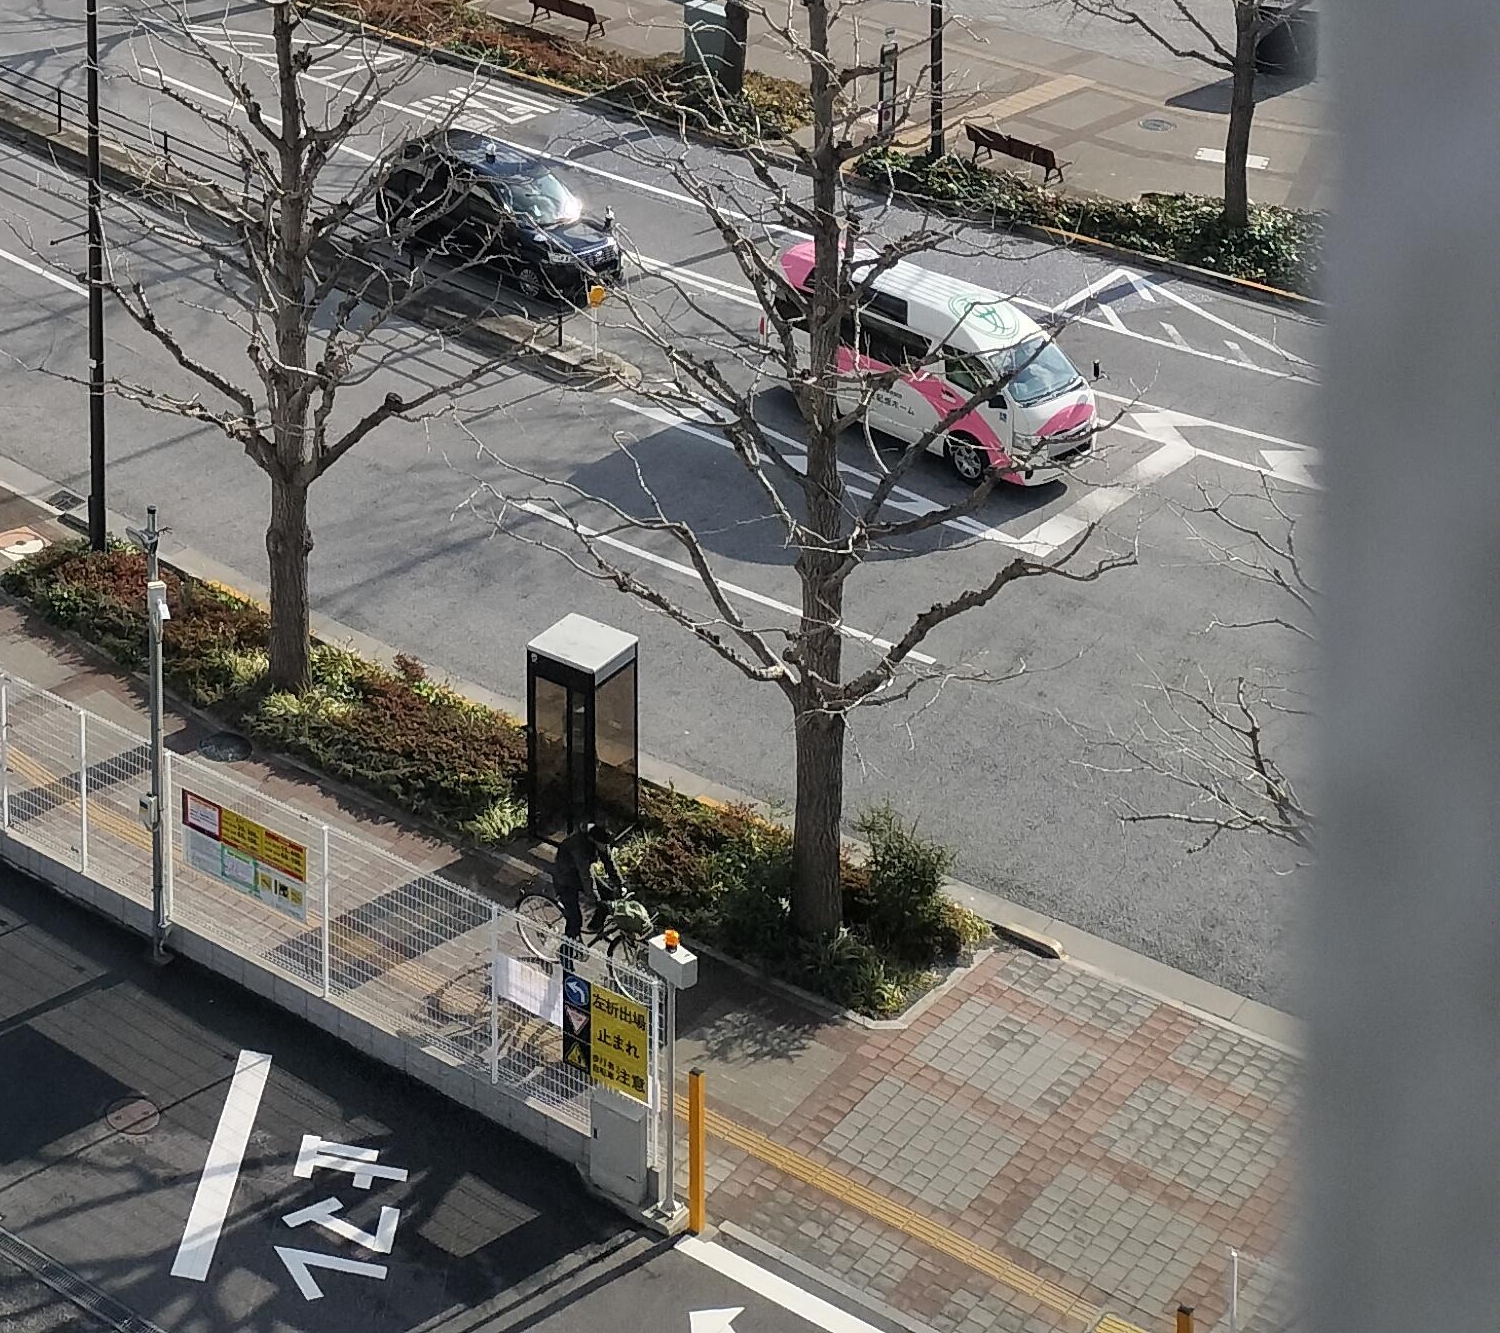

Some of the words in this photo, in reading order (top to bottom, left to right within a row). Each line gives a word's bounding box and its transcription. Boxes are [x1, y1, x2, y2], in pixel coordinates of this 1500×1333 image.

[592, 993, 647, 1032] 左折出場
[597, 1028, 641, 1060] 止まれ
[615, 1066, 646, 1094] 注意
